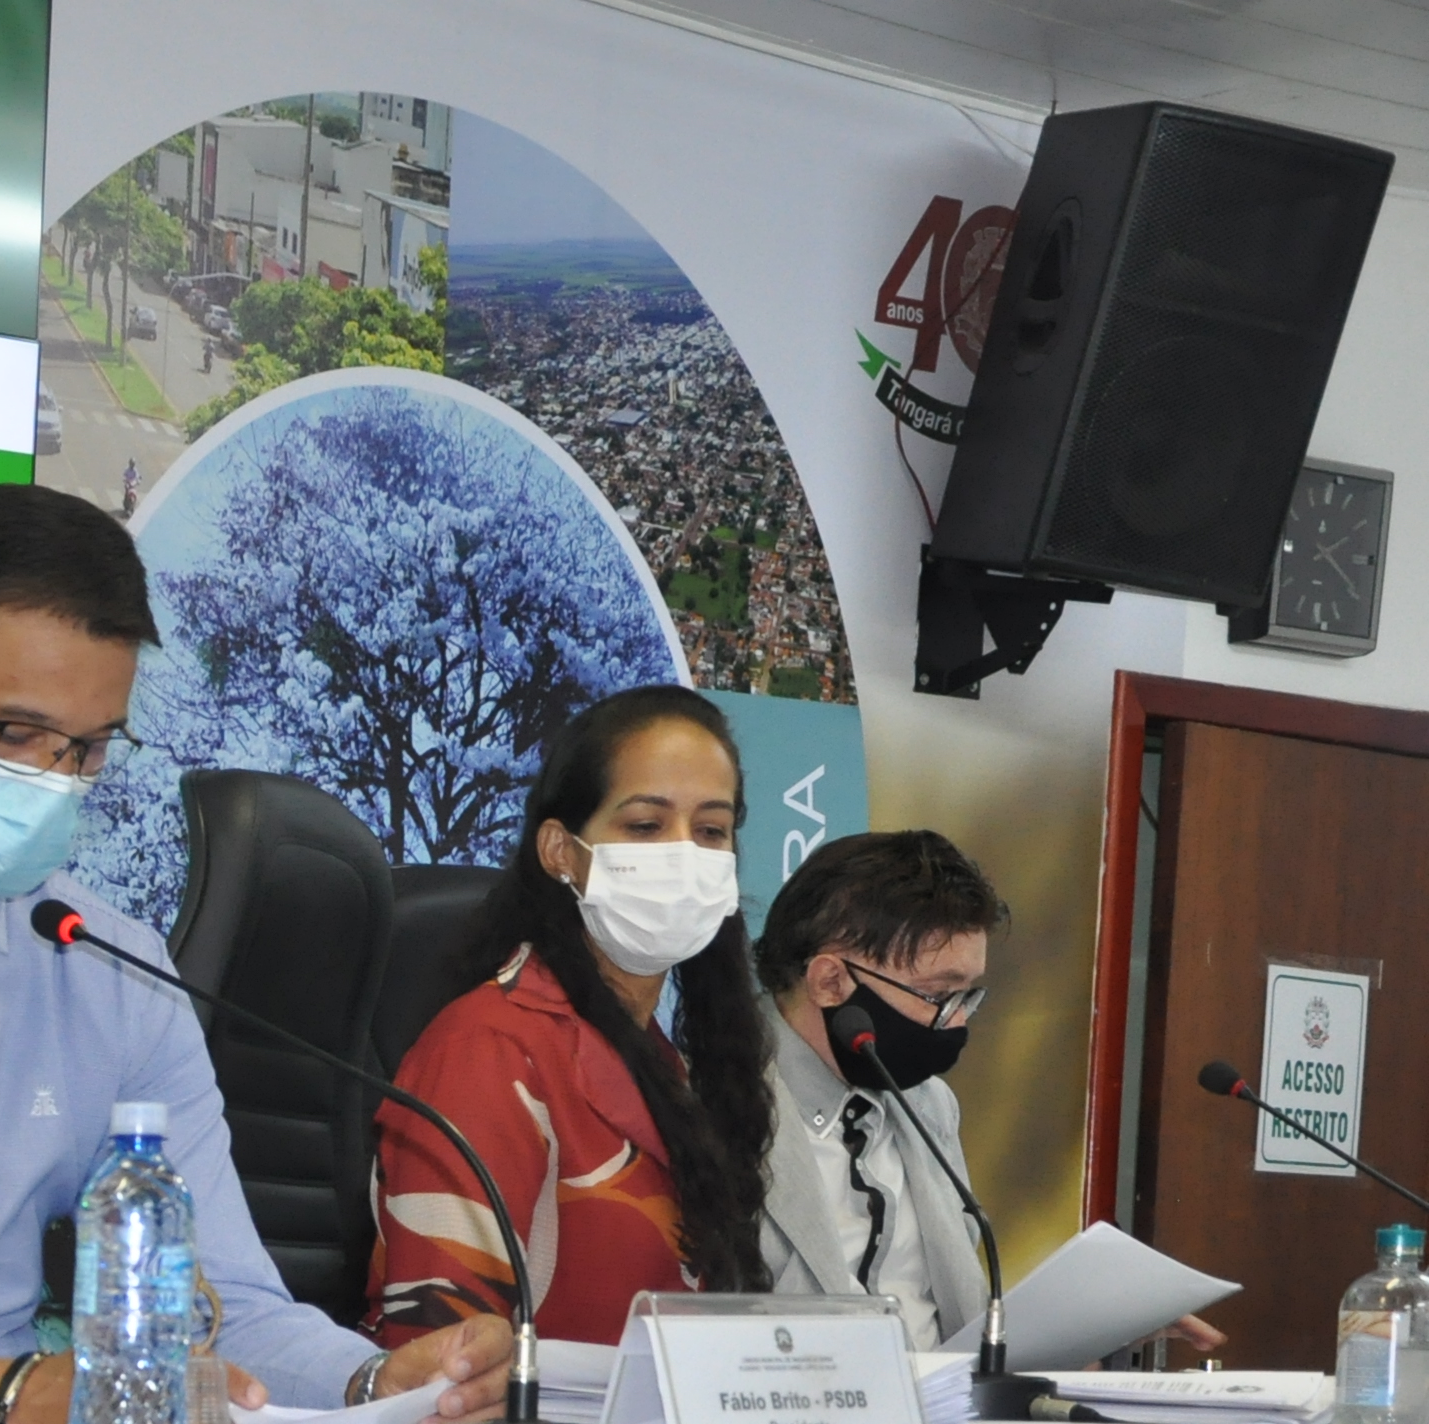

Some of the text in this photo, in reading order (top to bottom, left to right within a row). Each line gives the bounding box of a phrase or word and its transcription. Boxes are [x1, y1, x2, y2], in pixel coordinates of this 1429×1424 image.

[887, 302, 924, 323] anos
[887, 379, 952, 435] Tangará
[1281, 1059, 1345, 1096] ACESSO
[1271, 1107, 1348, 1143] RESTRITO
[719, 1391, 767, 1411] Fábio
[769, 1390, 811, 1410] Brito
[823, 1389, 869, 1409] PSDB
